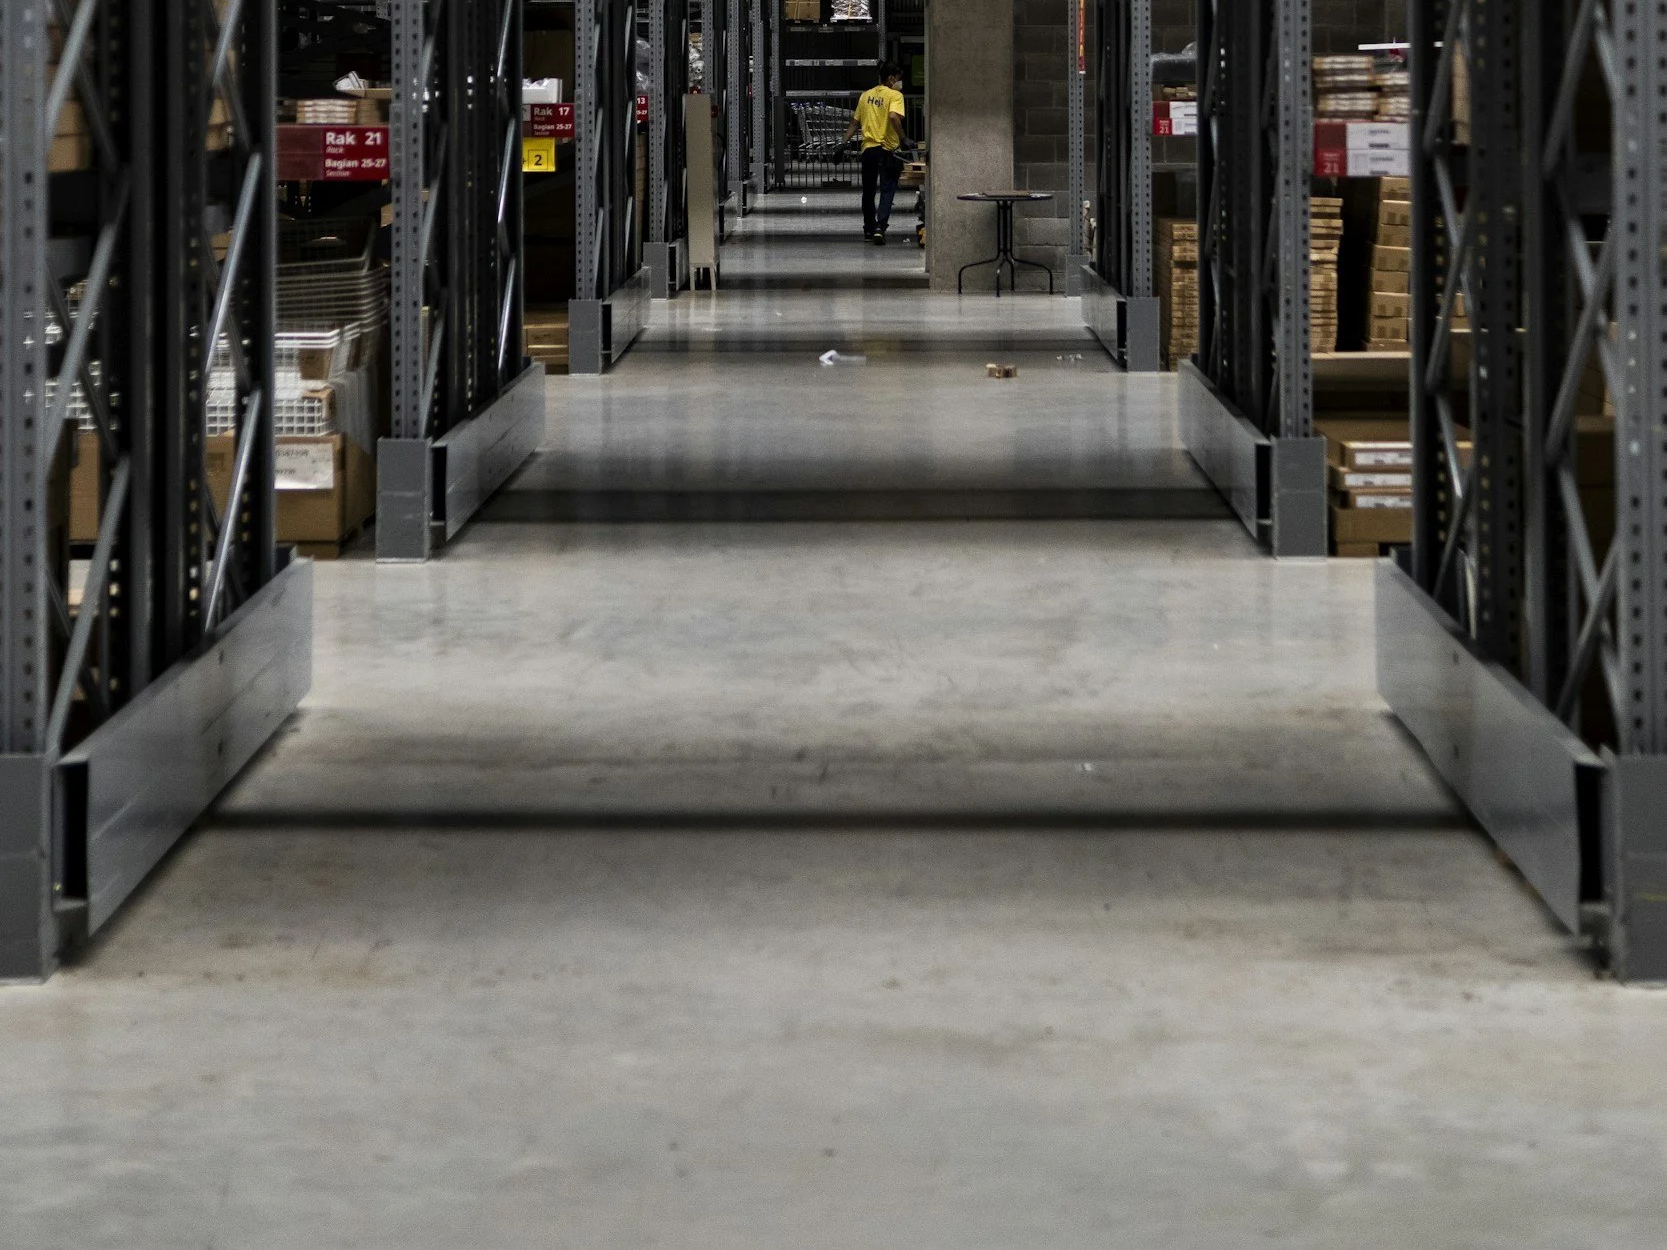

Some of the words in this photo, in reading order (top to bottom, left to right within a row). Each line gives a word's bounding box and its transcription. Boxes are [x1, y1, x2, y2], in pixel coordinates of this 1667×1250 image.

[533, 106, 553, 116] Rak
[558, 106, 571, 116] 17
[325, 130, 357, 146] Rak
[364, 131, 383, 146] 21
[325, 157, 360, 170] Bagian
[361, 157, 387, 169] 25-27
[534, 154, 543, 166] 2
